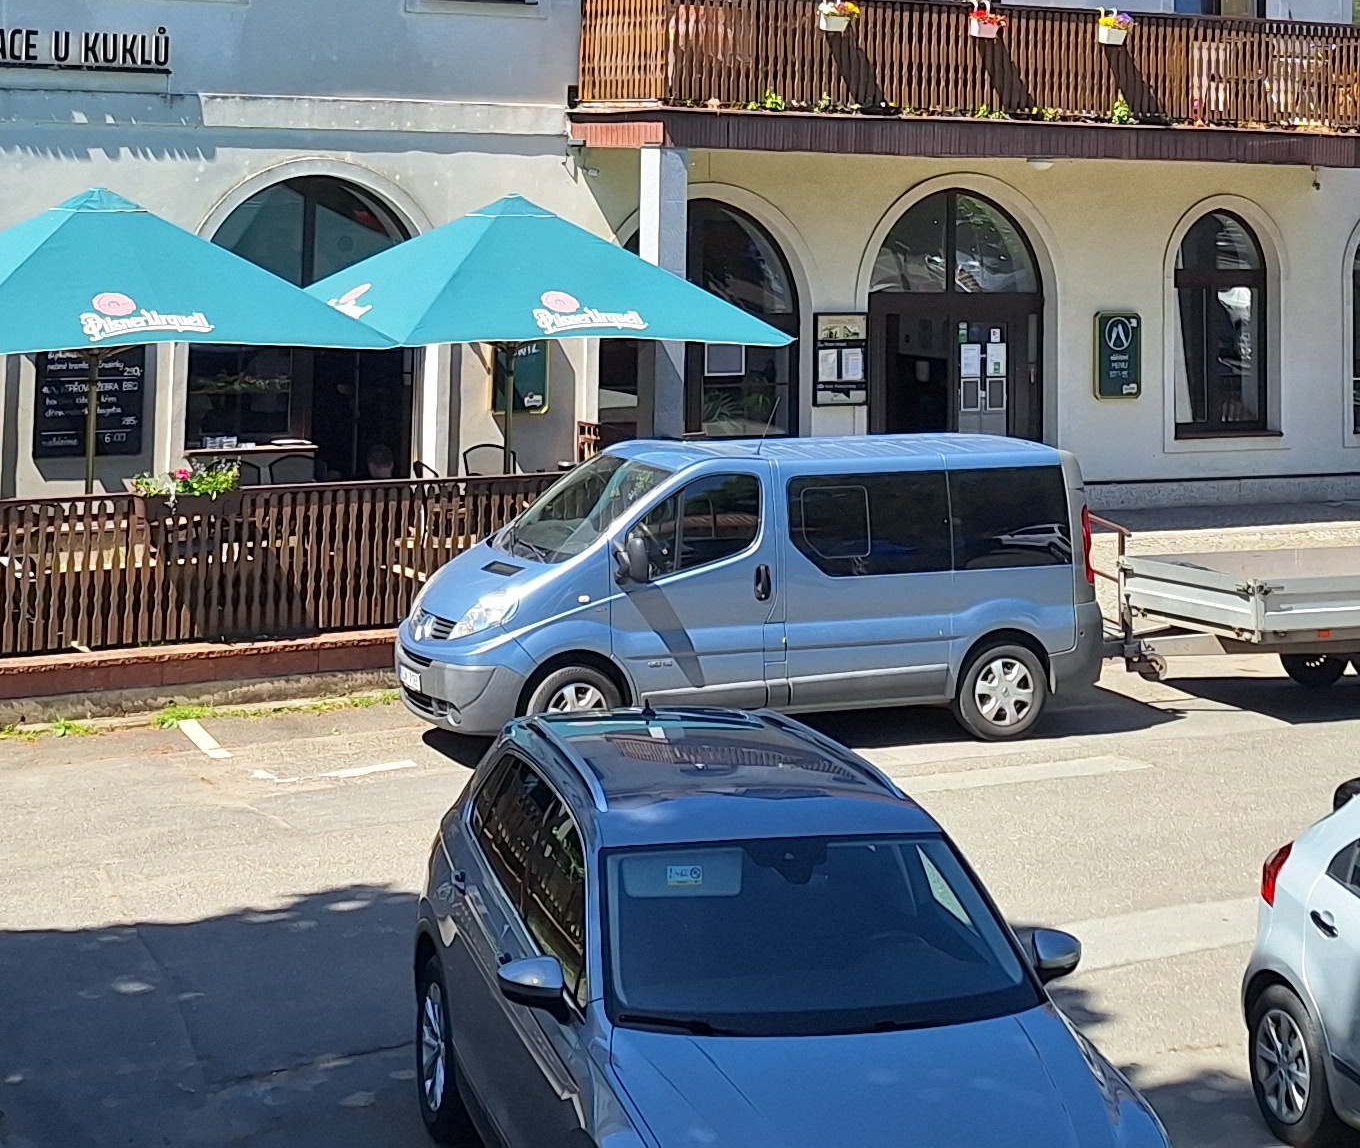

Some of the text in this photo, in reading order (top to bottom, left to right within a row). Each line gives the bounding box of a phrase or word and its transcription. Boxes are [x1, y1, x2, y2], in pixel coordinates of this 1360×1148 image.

[51, 30, 71, 63] U
[81, 26, 171, 67] KUKLŮ
[79, 308, 210, 342] Pilsner Urquell
[532, 306, 644, 335] Pilsner Urquell
